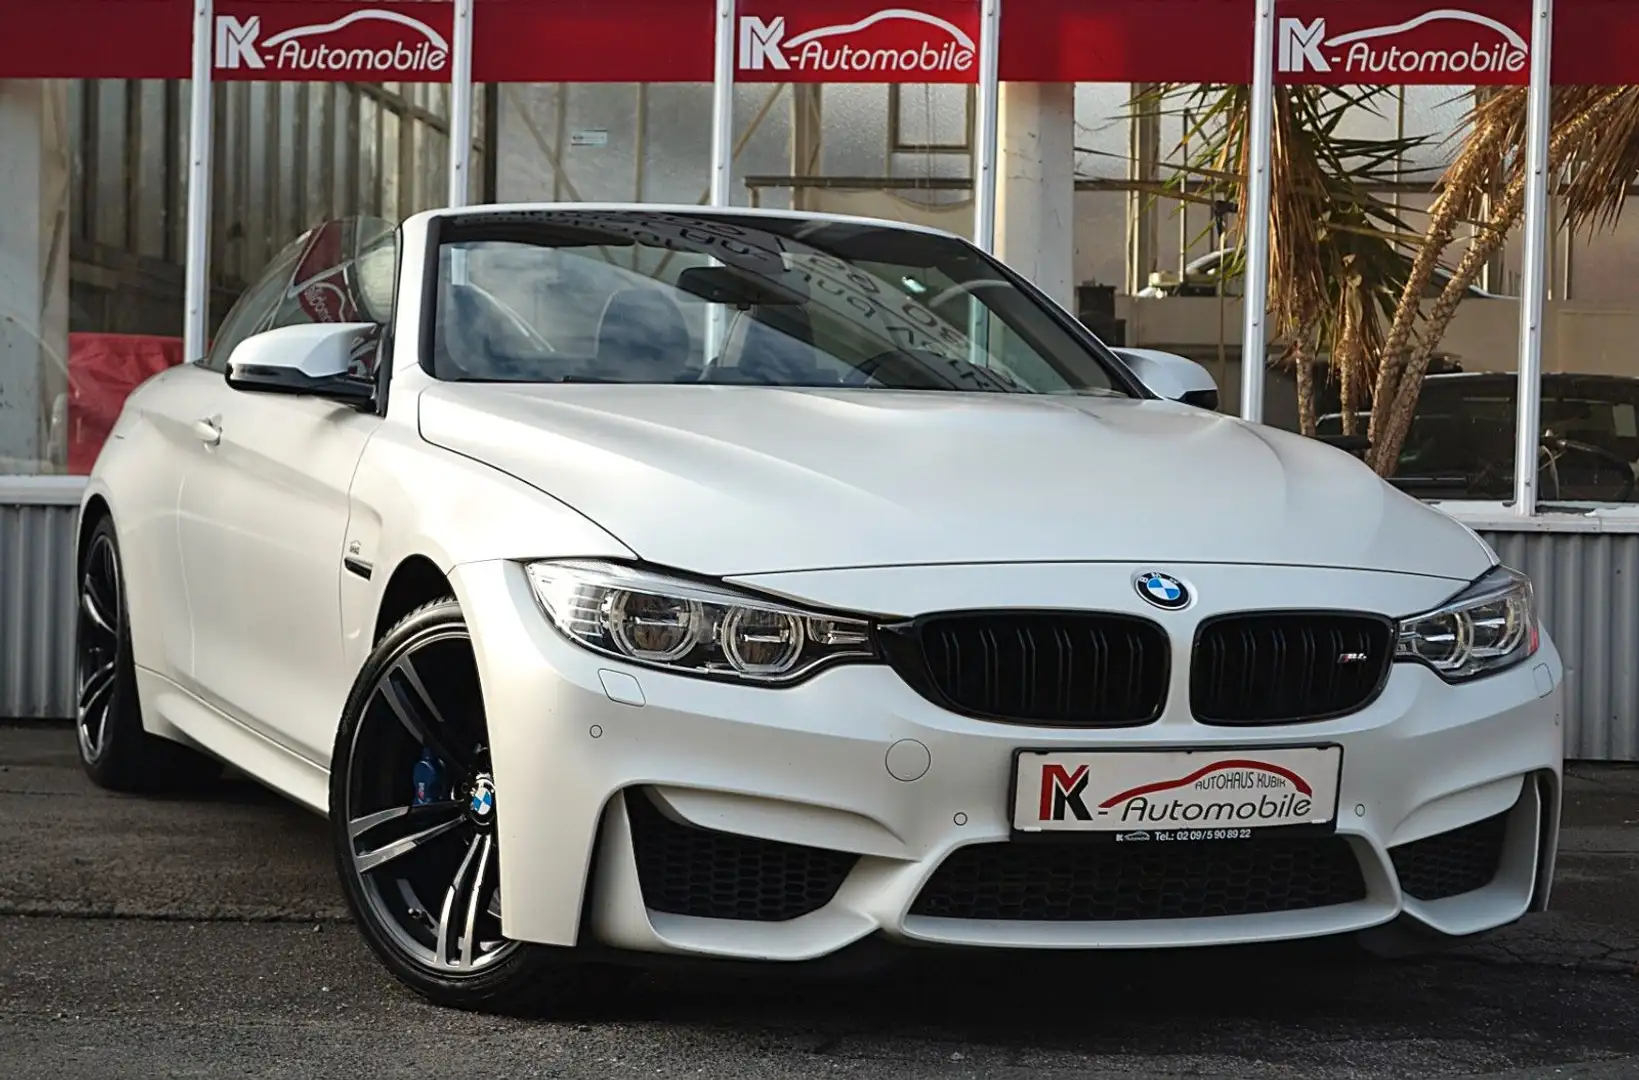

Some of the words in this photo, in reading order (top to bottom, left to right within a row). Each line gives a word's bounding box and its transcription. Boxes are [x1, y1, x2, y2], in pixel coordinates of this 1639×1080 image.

[1194, 771, 1254, 791] AUTOHAUS
[1256, 771, 1287, 789] KUBIK
[1154, 831, 1174, 841] Tel.:
